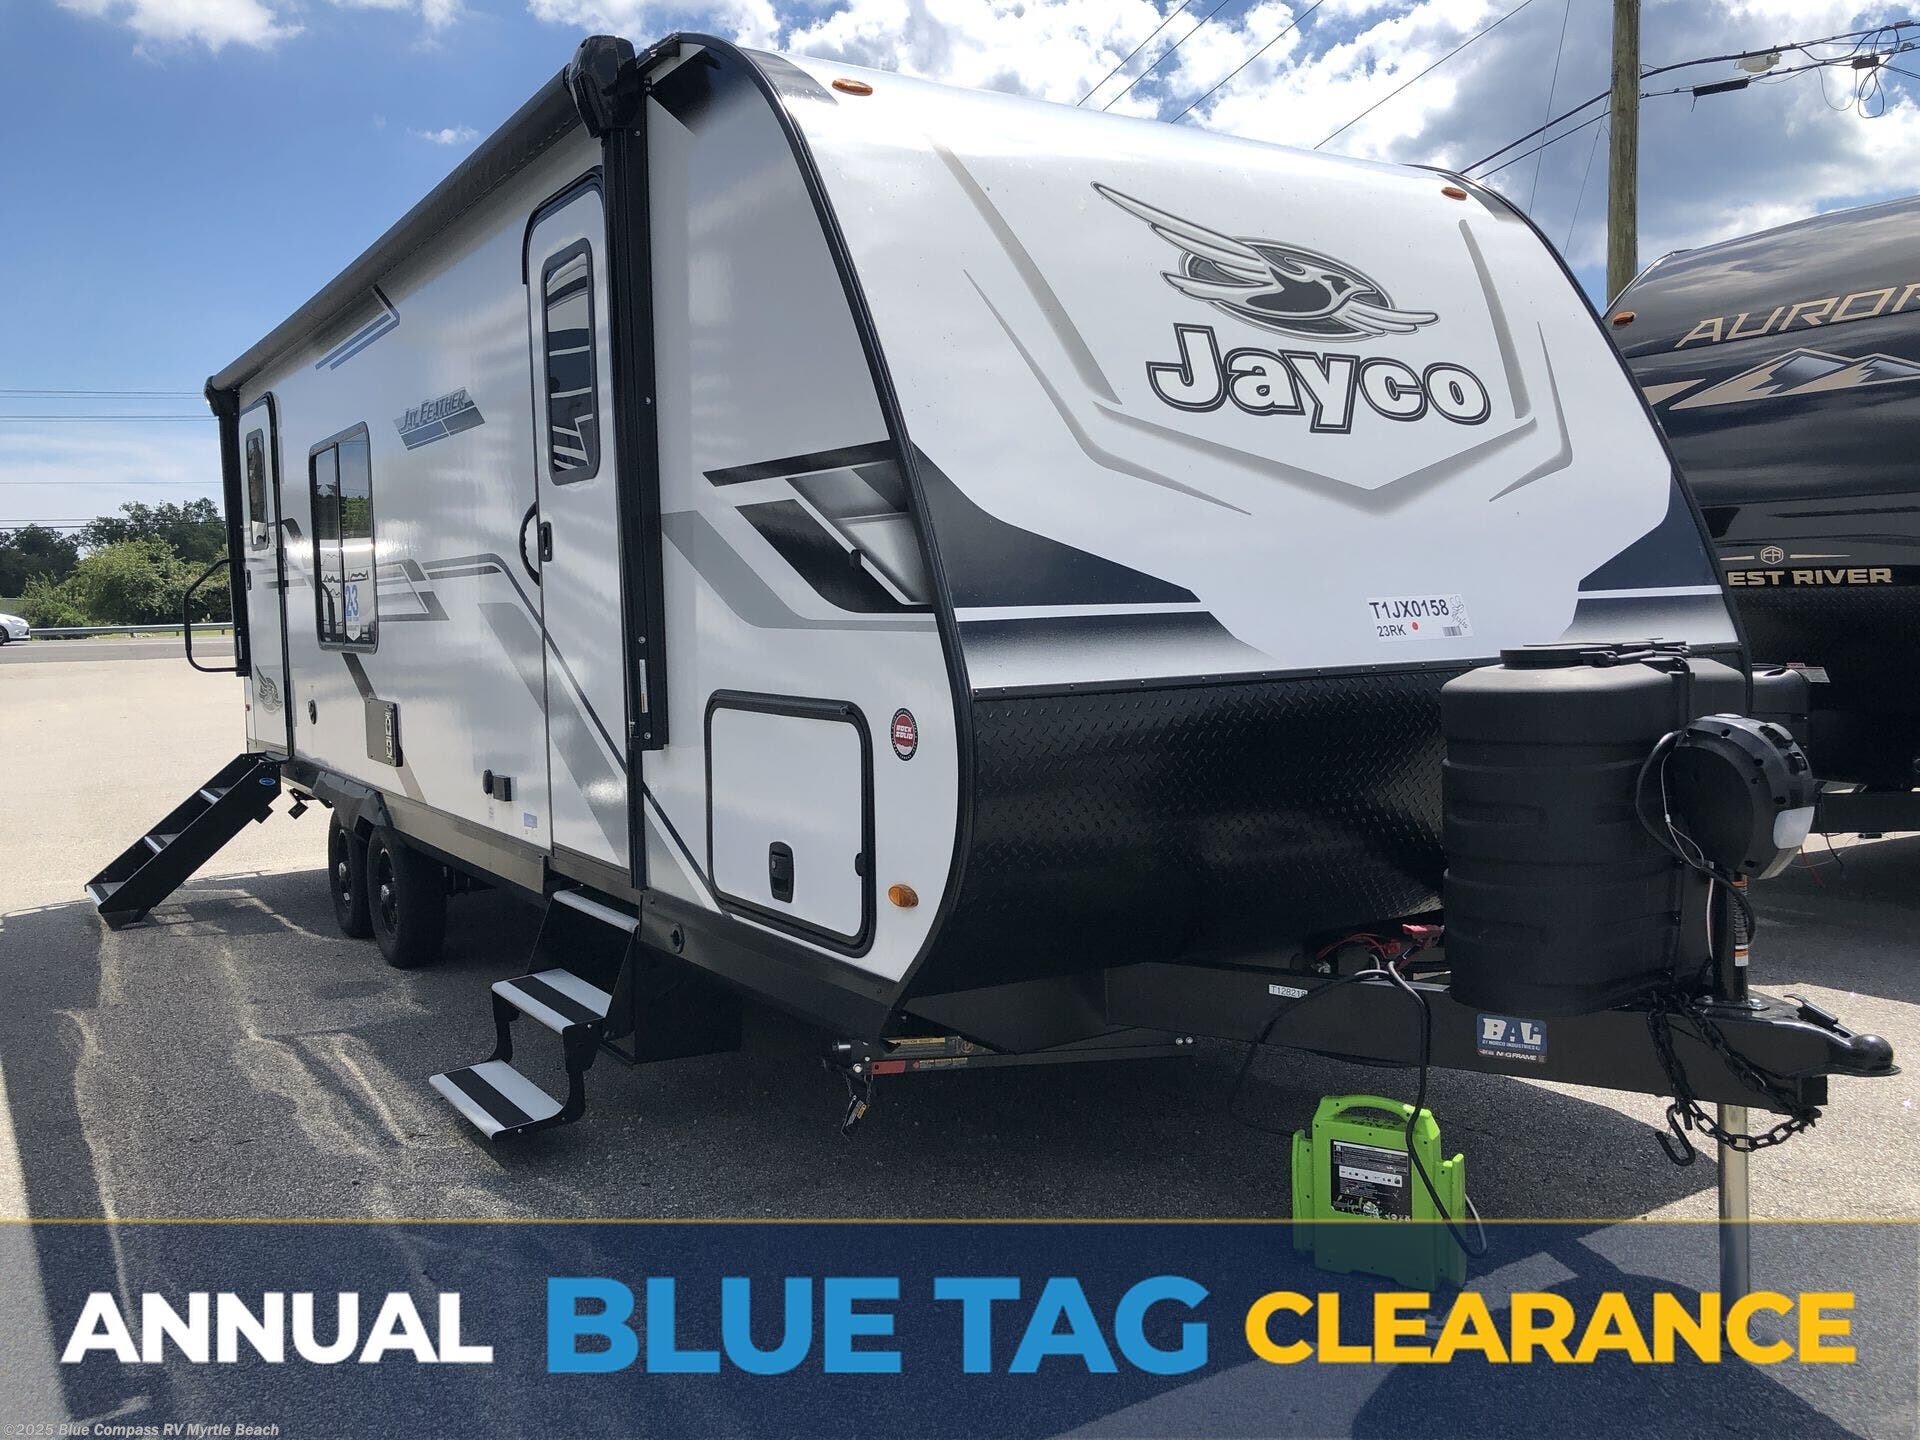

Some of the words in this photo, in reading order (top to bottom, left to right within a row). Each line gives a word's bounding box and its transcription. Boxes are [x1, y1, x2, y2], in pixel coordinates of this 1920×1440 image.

[1146, 323, 1491, 434] Jayco
[419, 390, 466, 423] FEATHER
[1791, 568, 1893, 585] RIVER
[1369, 599, 1449, 619] T1JX0158
[1376, 624, 1407, 637] 23RK
